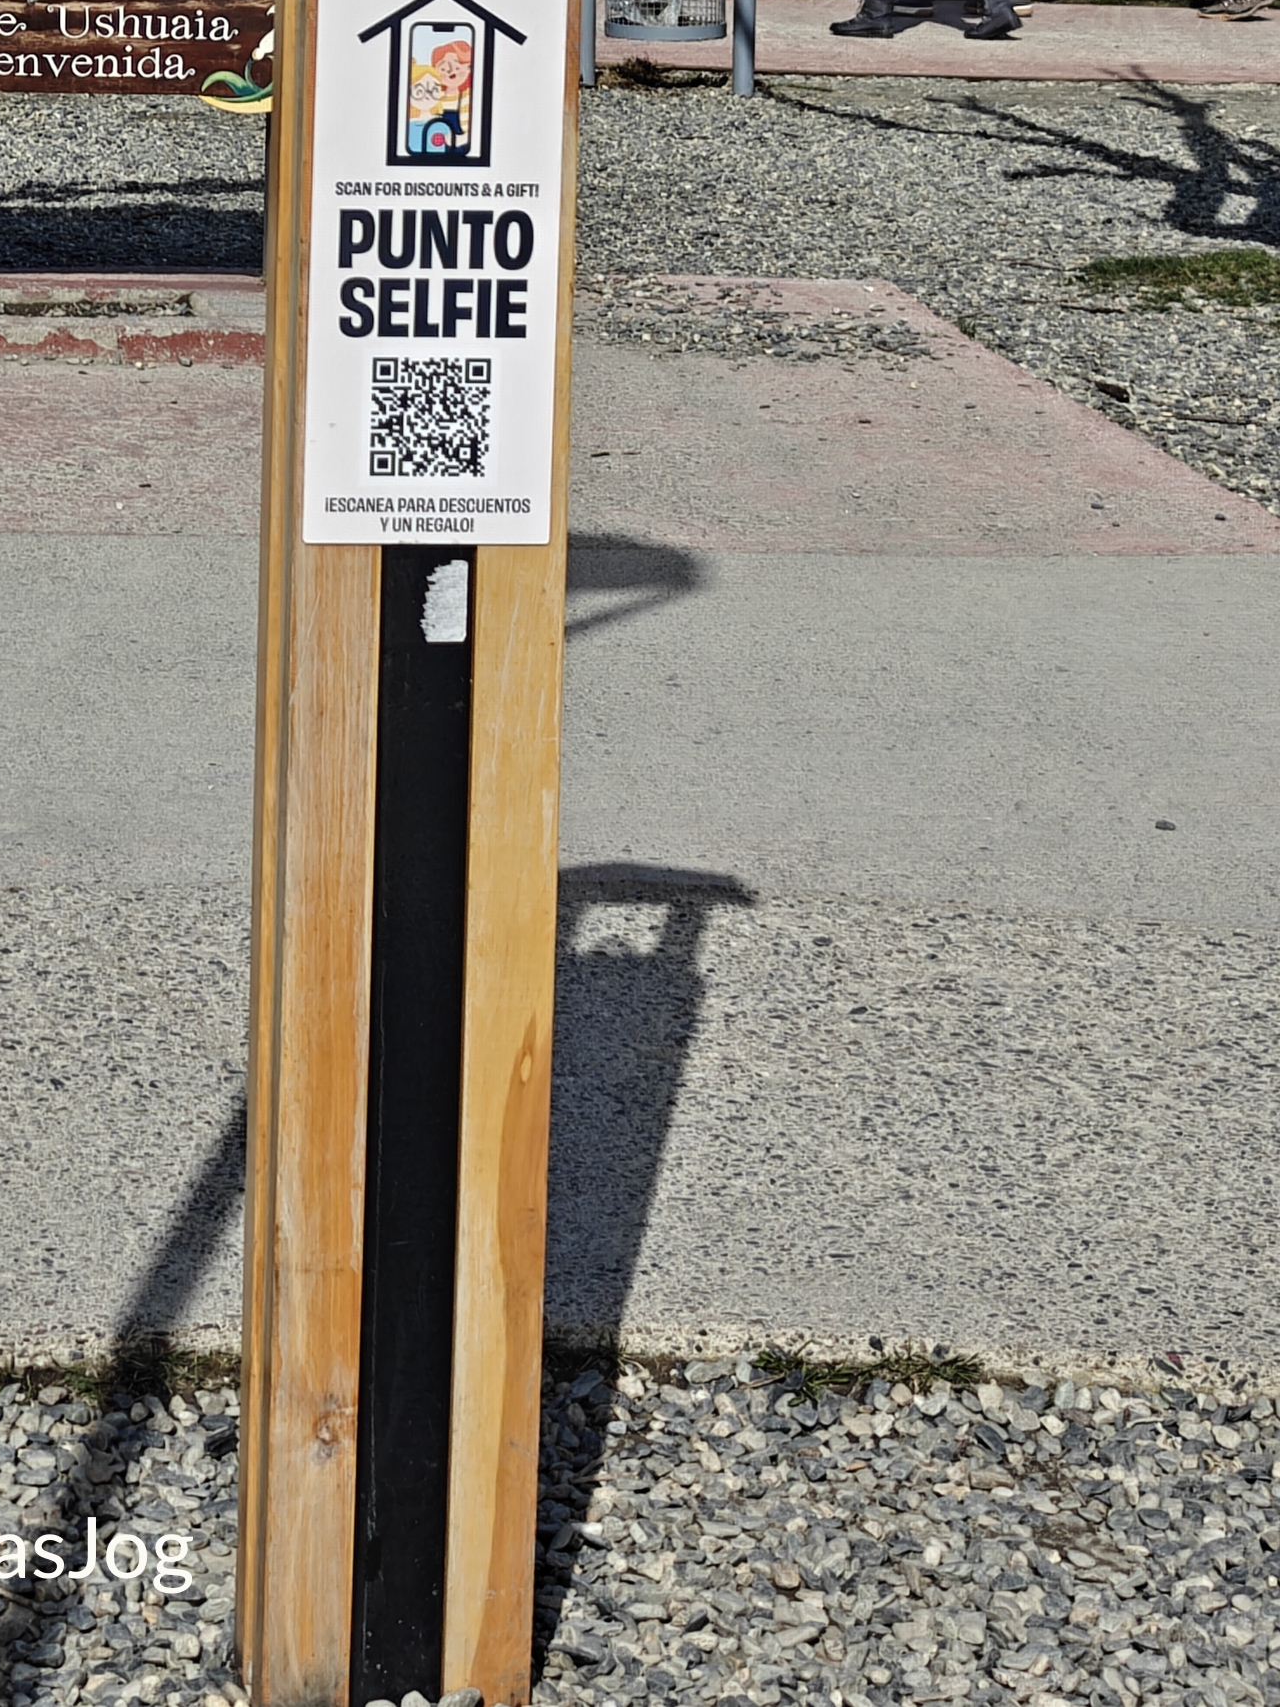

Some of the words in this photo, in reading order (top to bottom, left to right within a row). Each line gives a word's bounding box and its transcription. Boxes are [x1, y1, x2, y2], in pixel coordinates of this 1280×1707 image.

[48, 5, 239, 41] Ushuaia
[335, 181, 372, 196] SCAN
[374, 182, 402, 196] FOR
[404, 182, 480, 197] DISCOUNTS
[481, 183, 491, 197] &
[493, 183, 504, 198] A
[506, 183, 540, 198] GIFT!
[338, 208, 534, 270] PUNTO
[338, 277, 528, 338] SELFIE
[397, 497, 436, 513] PARA
[439, 498, 531, 513] DESCUENTOS
[380, 517, 390, 532] Y
[392, 517, 412, 532] UN
[416, 517, 474, 533] REGALO!
